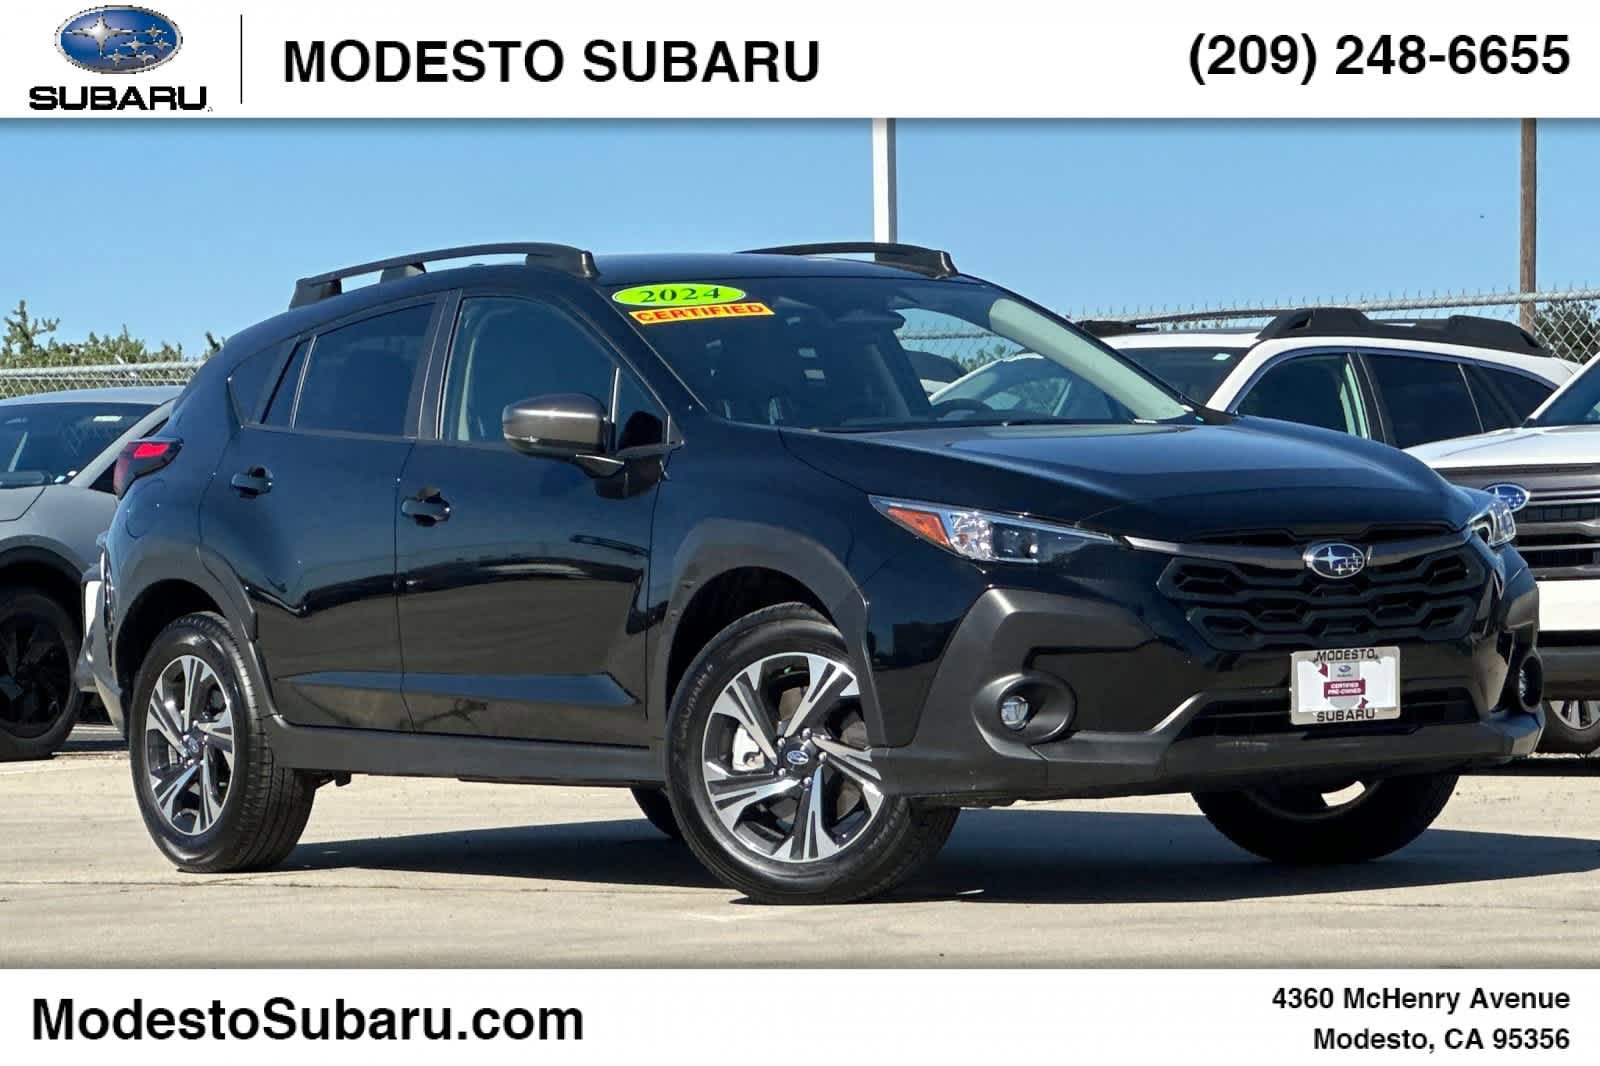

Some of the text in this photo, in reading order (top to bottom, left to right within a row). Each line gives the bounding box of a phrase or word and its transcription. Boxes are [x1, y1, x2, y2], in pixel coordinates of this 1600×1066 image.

[639, 287, 721, 303] 2024
[637, 304, 766, 322] CERTIFIED
[1316, 648, 1376, 662] MODESTO
[1316, 707, 1375, 722] SUBARU
